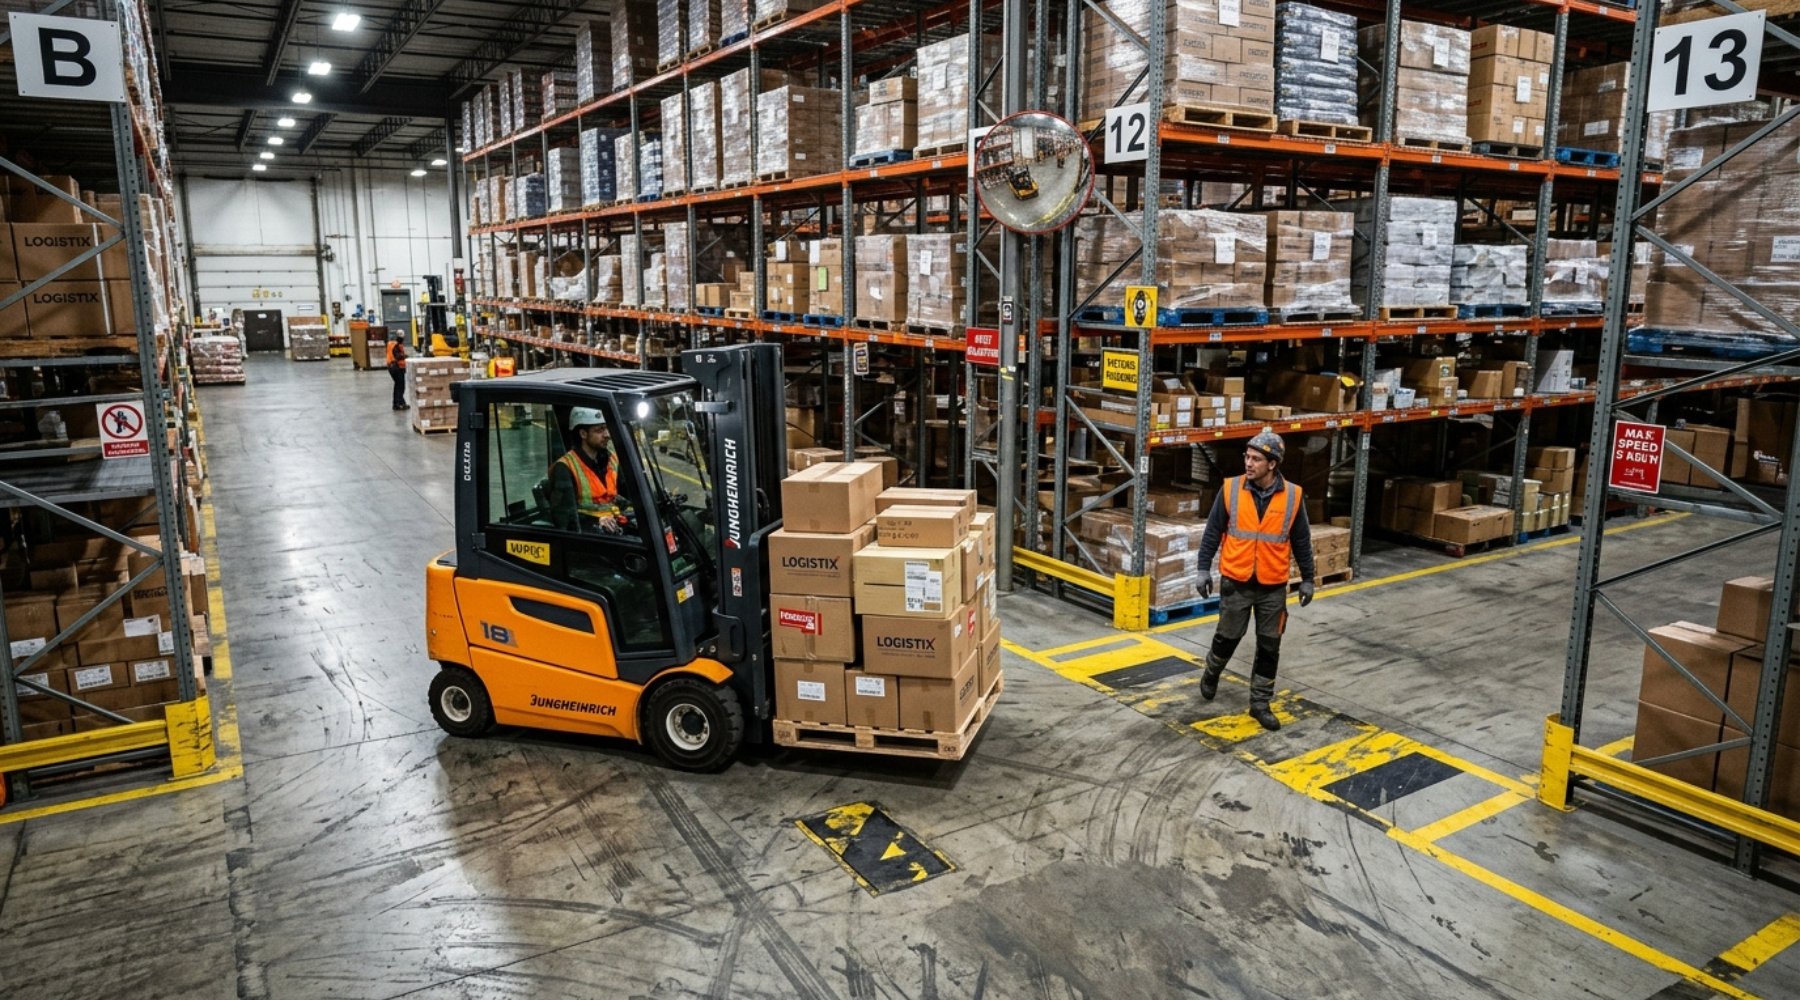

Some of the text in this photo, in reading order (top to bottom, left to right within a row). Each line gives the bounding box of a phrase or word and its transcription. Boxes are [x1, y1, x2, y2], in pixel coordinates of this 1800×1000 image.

[38, 27, 97, 87] B
[1664, 29, 1747, 96] 13
[1110, 112, 1146, 154] 12
[33, 292, 99, 304] LOGISTIX
[1618, 438, 1659, 453] SPEED
[782, 556, 839, 570] LOGISTIX
[877, 636, 936, 650] LOGISTIX
